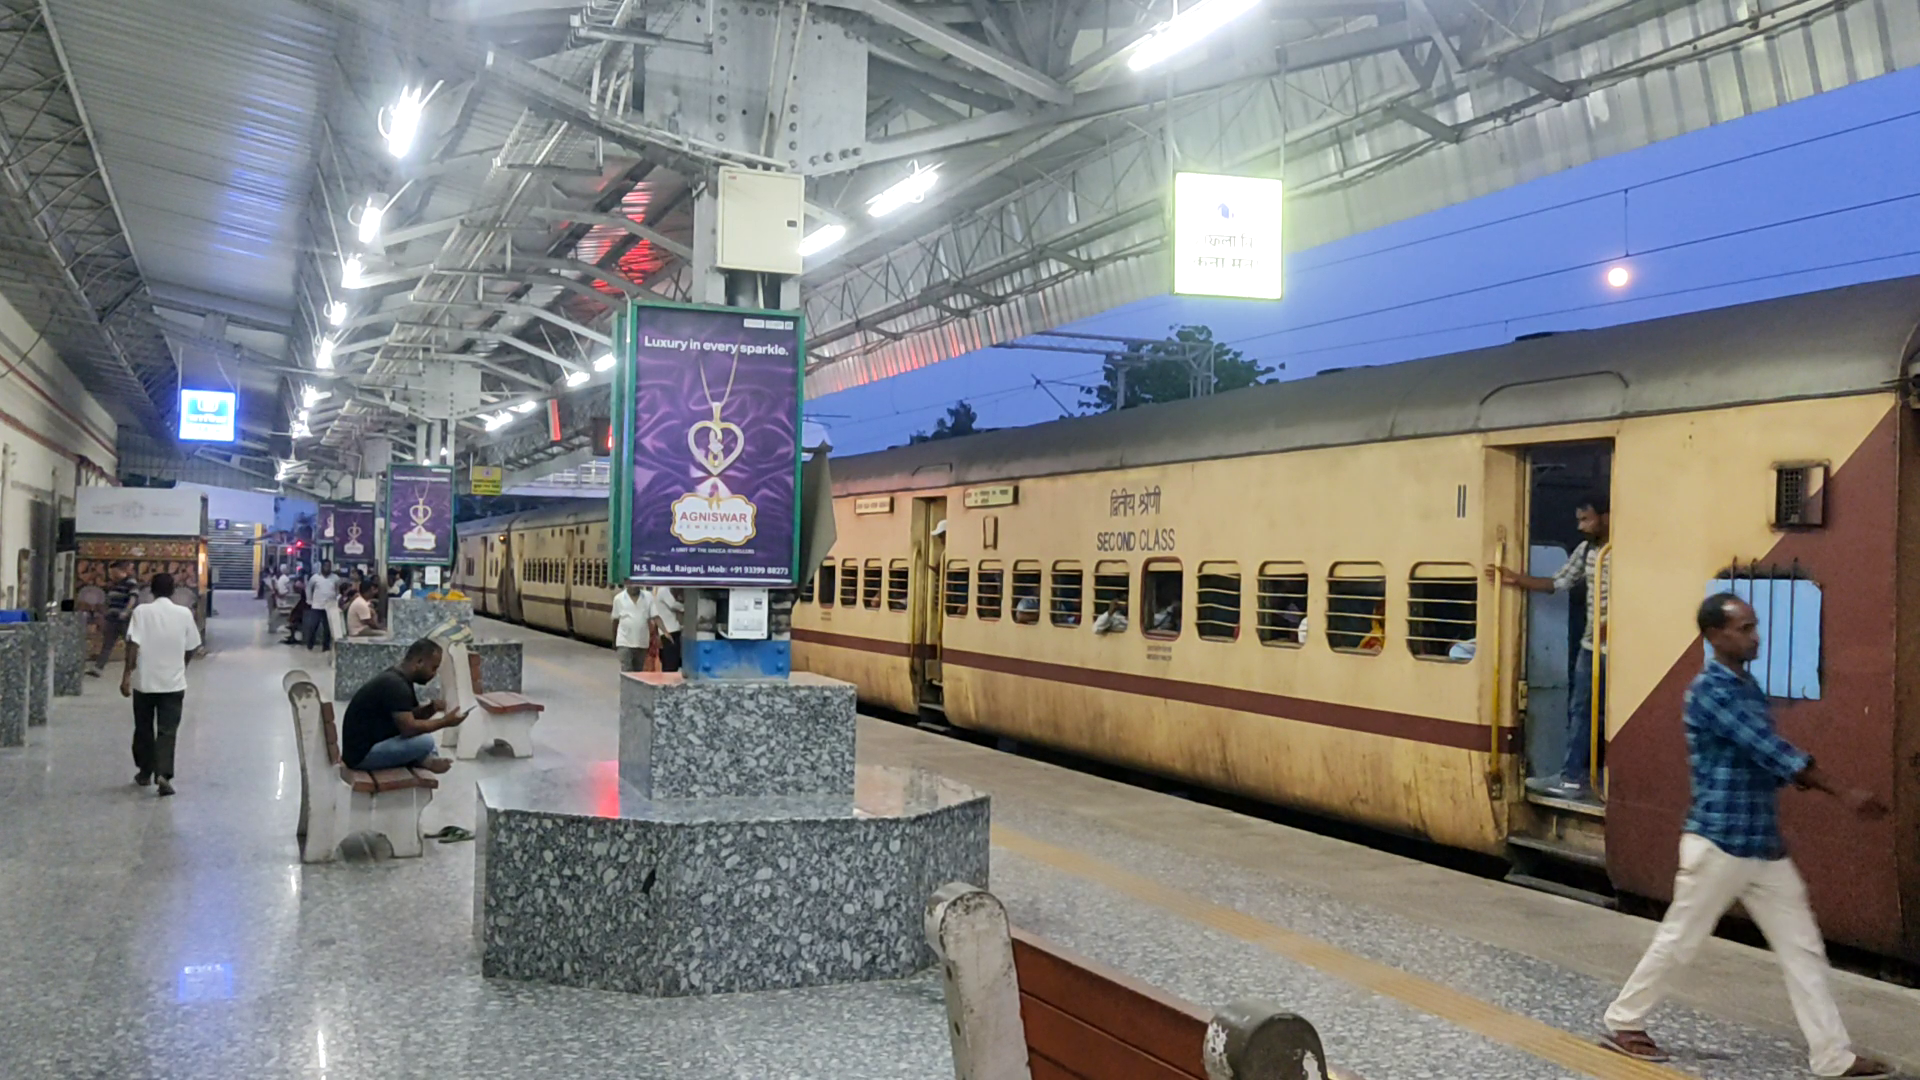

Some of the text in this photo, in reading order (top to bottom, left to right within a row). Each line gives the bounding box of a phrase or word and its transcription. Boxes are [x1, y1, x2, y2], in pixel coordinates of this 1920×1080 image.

[644, 335, 789, 356] Luxury in every sparkle.
[1110, 485, 1161, 518] द्वितीय श्रेणी
[217, 519, 227, 530] 2
[680, 511, 748, 523] AGNISWAR
[1097, 528, 1175, 552] SECOND CLASS
[633, 563, 648, 572] N.S.
[650, 564, 673, 573] Road,
[674, 564, 706, 574] Raiganj,
[707, 565, 728, 573] Mob:
[729, 566, 743, 574] +91
